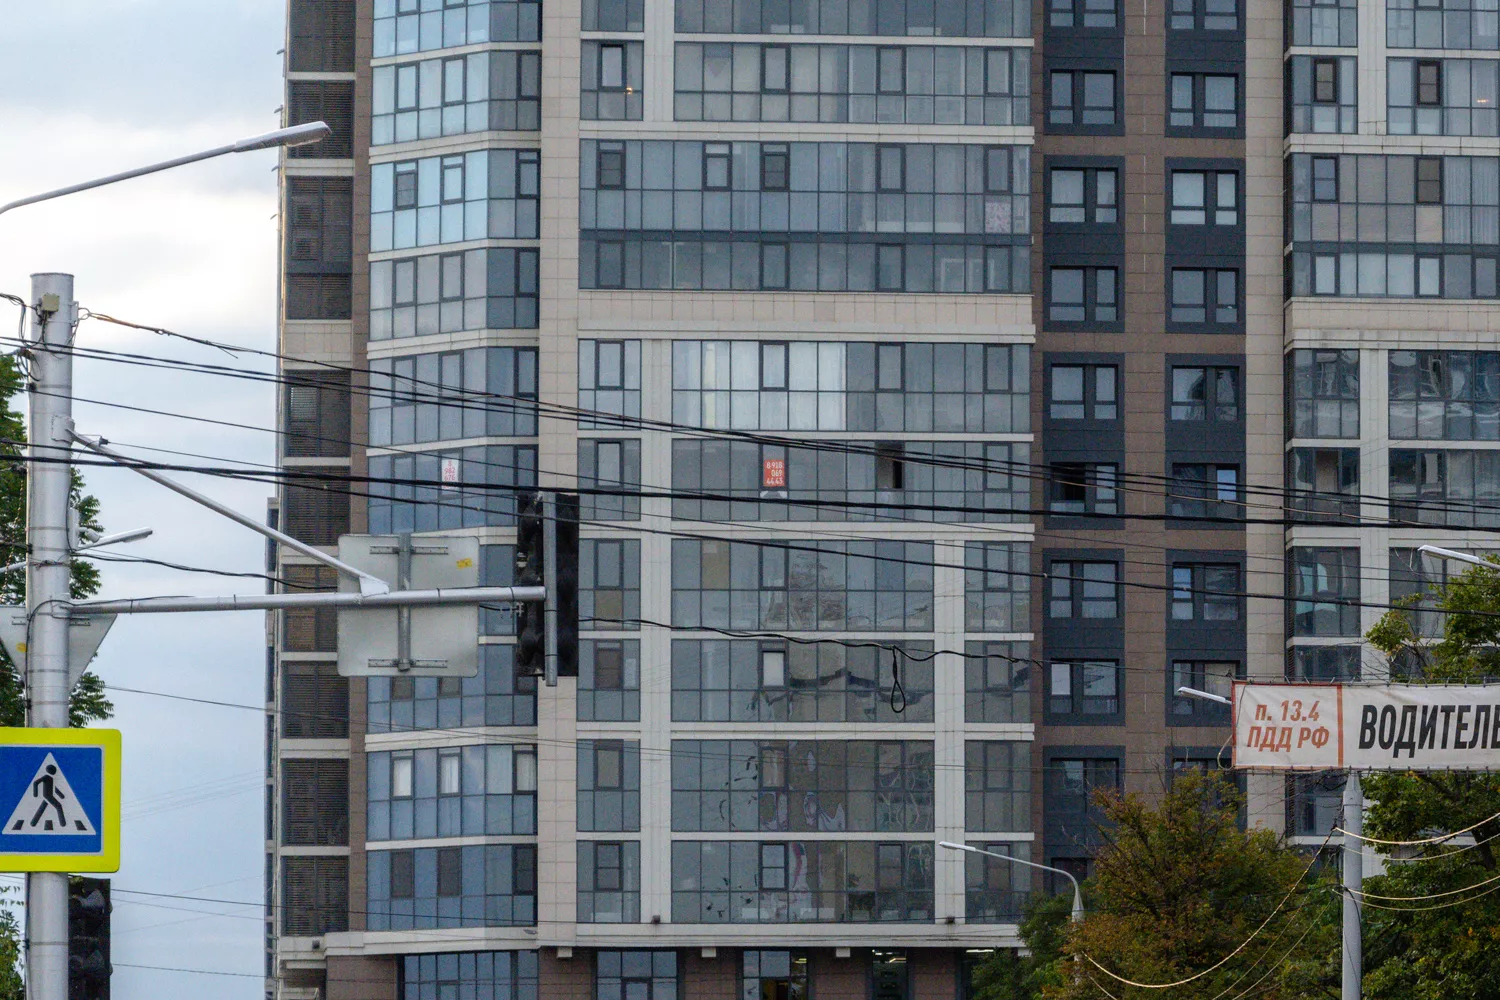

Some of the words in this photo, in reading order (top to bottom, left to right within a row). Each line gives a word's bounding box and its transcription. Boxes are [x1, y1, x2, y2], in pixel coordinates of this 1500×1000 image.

[1255, 704, 1272, 721] п.
[1280, 700, 1319, 722] 13.4
[1247, 726, 1292, 752] ПДД
[1297, 726, 1330, 749] РФ
